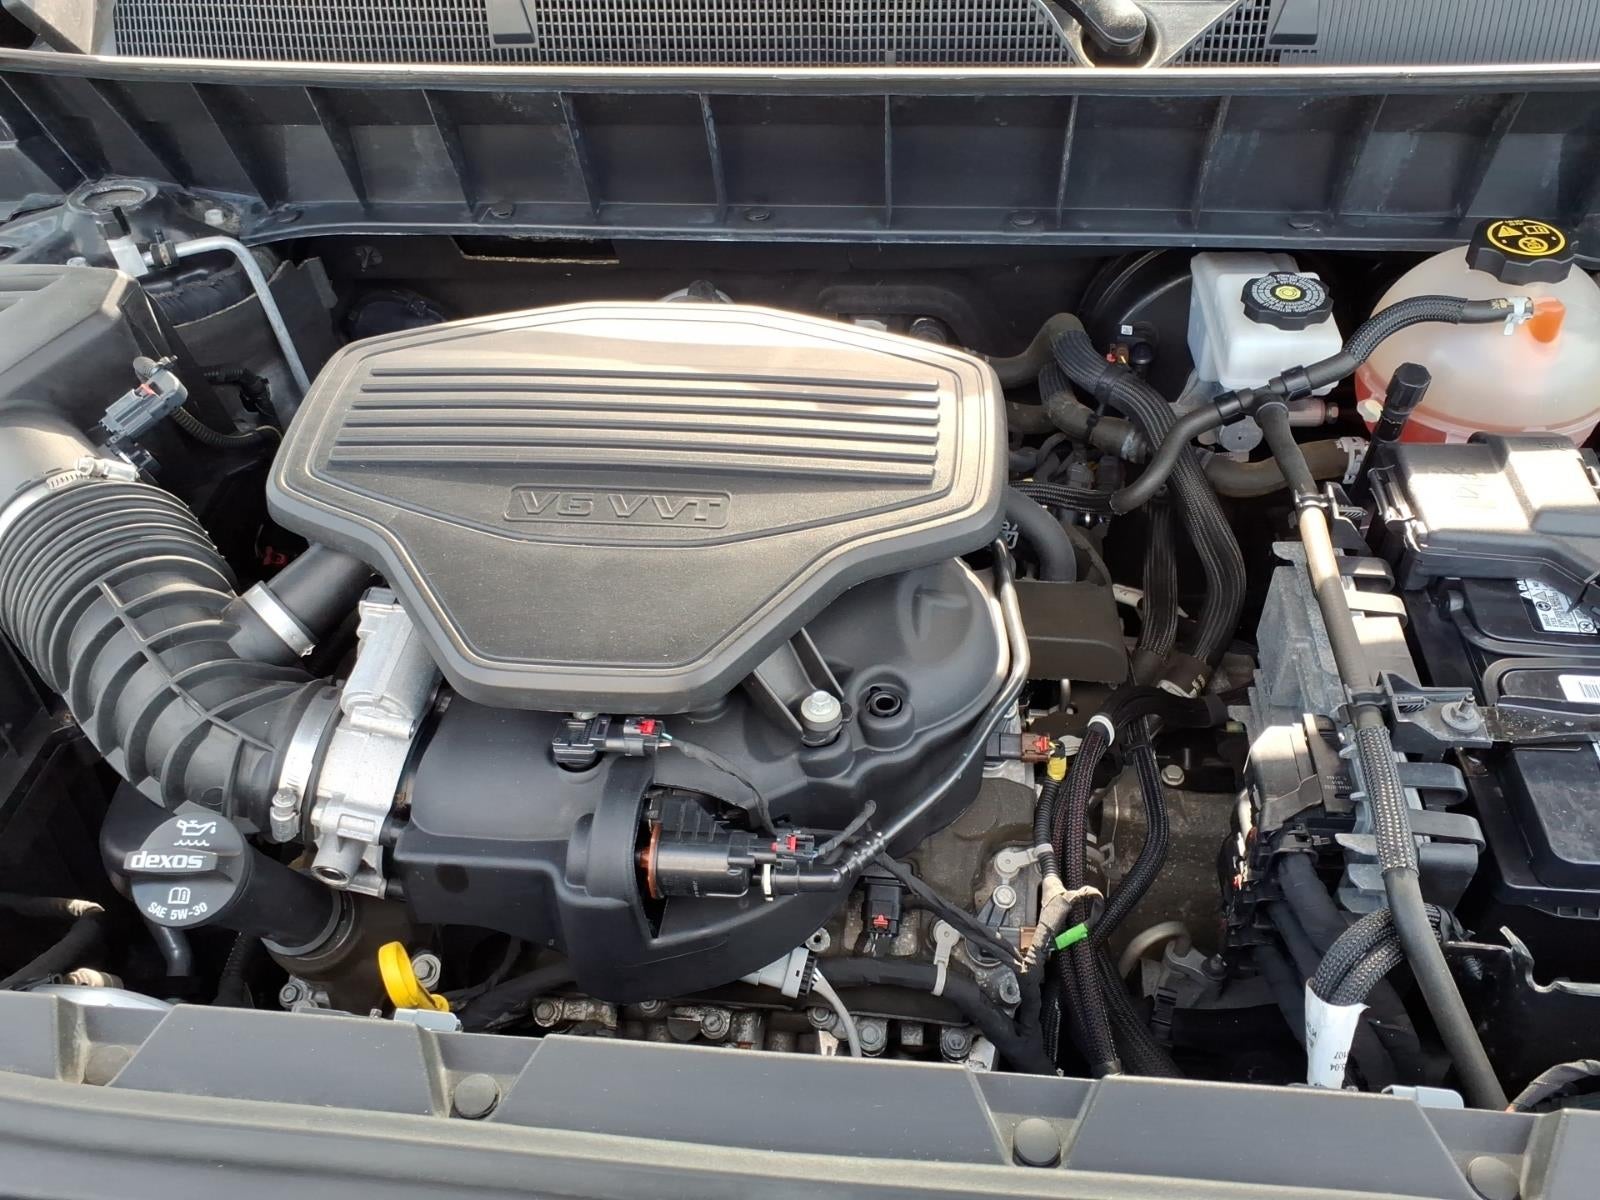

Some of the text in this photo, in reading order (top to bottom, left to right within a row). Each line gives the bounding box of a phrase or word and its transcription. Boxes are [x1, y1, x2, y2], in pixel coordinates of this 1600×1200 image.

[519, 491, 722, 521] V6 VVT
[130, 850, 204, 869] dexos
[147, 901, 208, 920] SAE 5W-30
